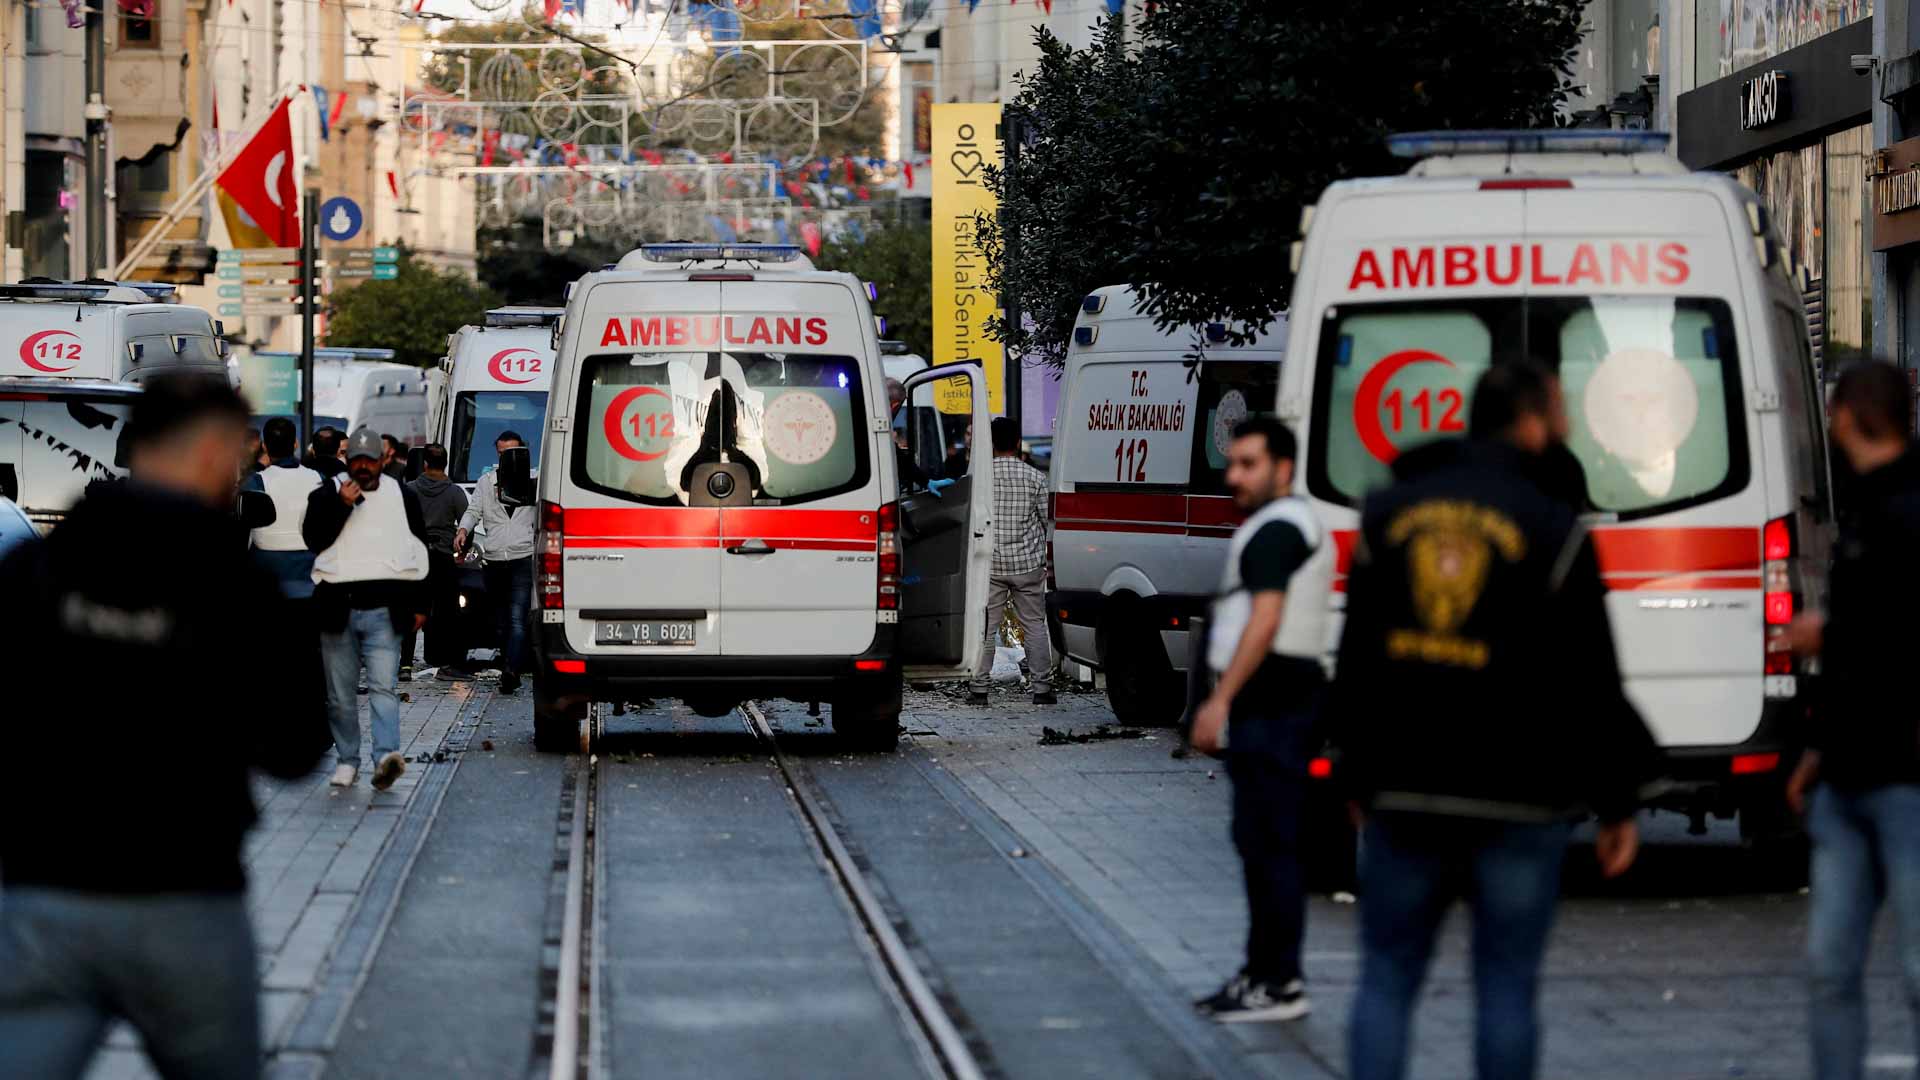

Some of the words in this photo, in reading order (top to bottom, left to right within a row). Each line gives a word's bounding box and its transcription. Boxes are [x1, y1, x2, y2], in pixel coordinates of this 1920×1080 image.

[1346, 243, 1691, 292] AMBULANS
[600, 316, 829, 347] AMBULANS
[37, 341, 82, 361] 112
[504, 358, 543, 374] 112
[1131, 370, 1149, 397] T.C.
[1088, 400, 1127, 431] SAĞLIK
[1127, 400, 1186, 432] BAKANLIĞI
[1382, 387, 1465, 433] 112
[628, 413, 676, 438] 112
[1115, 438, 1148, 482] 112
[606, 623, 623, 640] 34
[632, 623, 650, 640] YB
[660, 623, 693, 640] 6021
